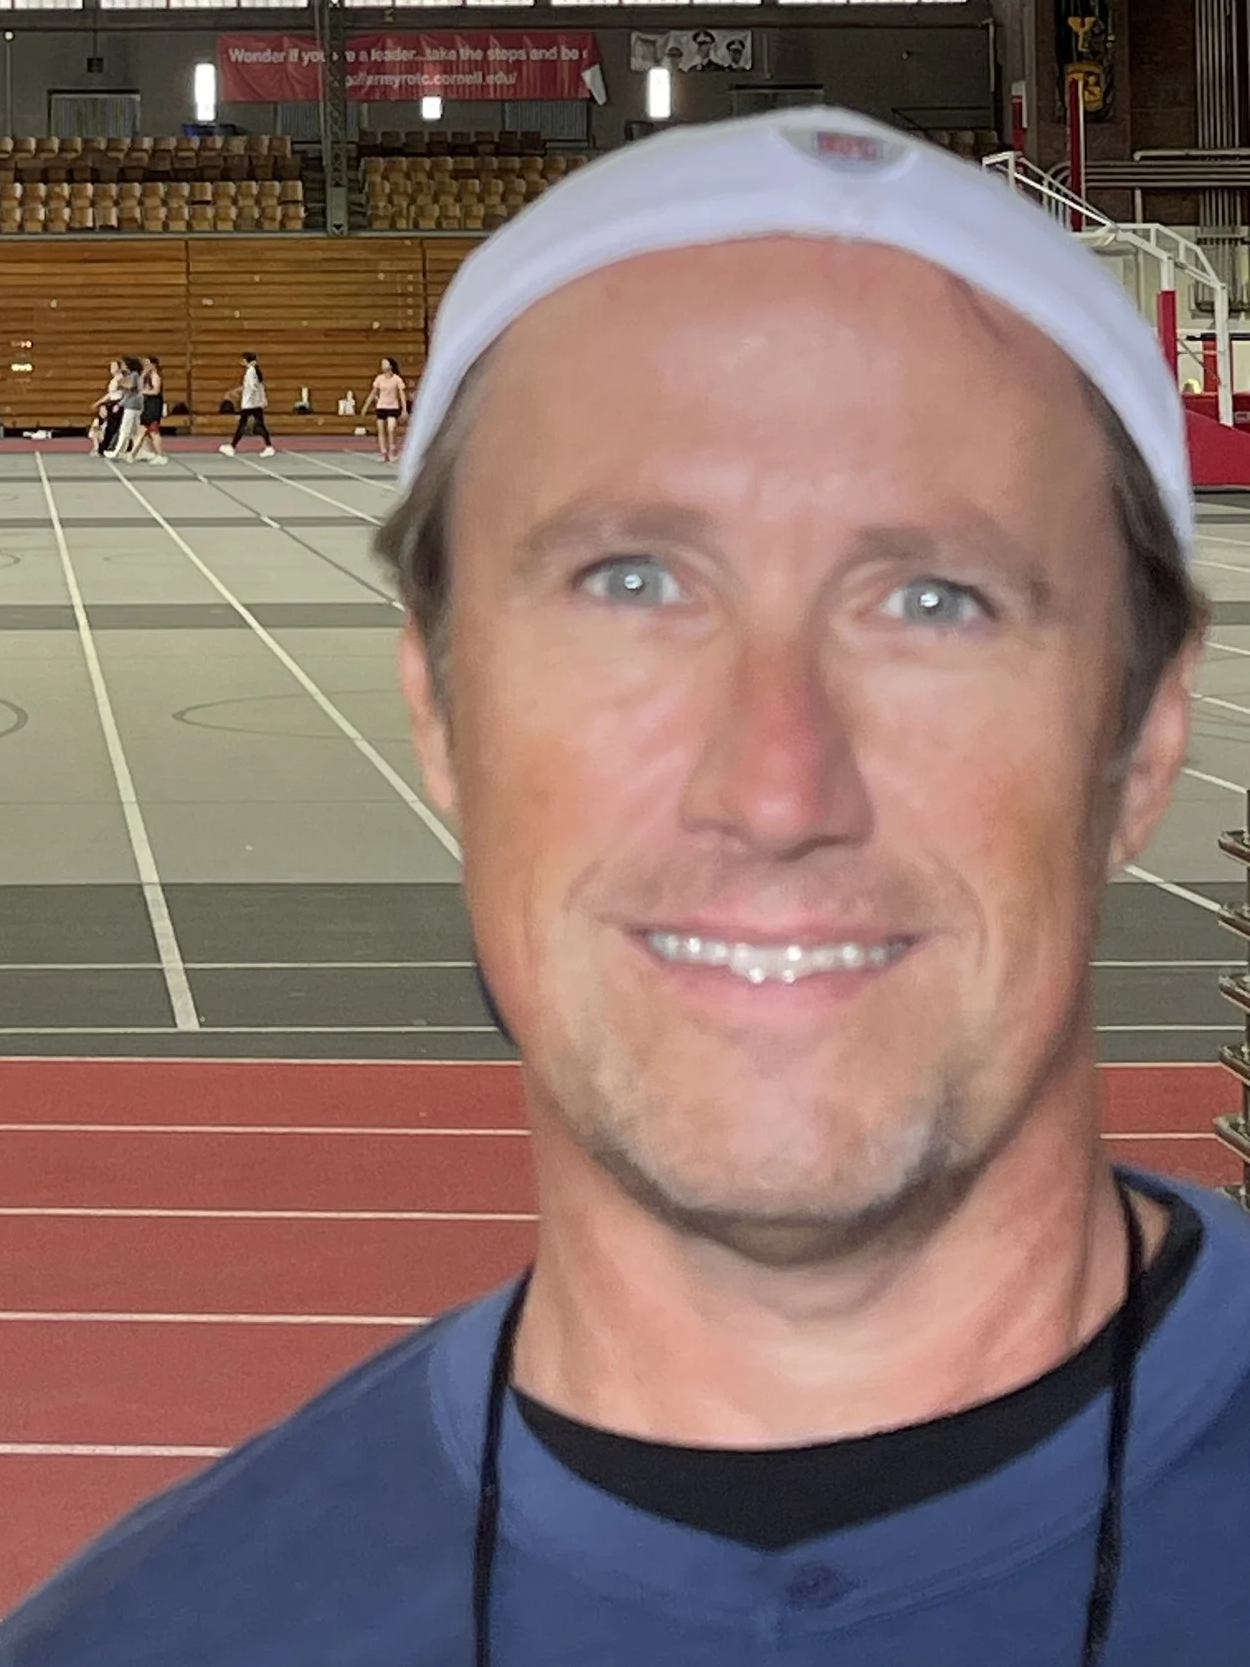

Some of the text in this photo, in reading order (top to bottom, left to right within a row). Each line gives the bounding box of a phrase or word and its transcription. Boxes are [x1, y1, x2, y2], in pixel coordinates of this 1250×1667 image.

[228, 48, 286, 63] Wonder
[459, 47, 484, 61] the
[486, 46, 527, 64] steps
[529, 46, 558, 61] and
[560, 45, 580, 61] be
[344, 70, 517, 89] p://armyrotc.cornell.edu/
